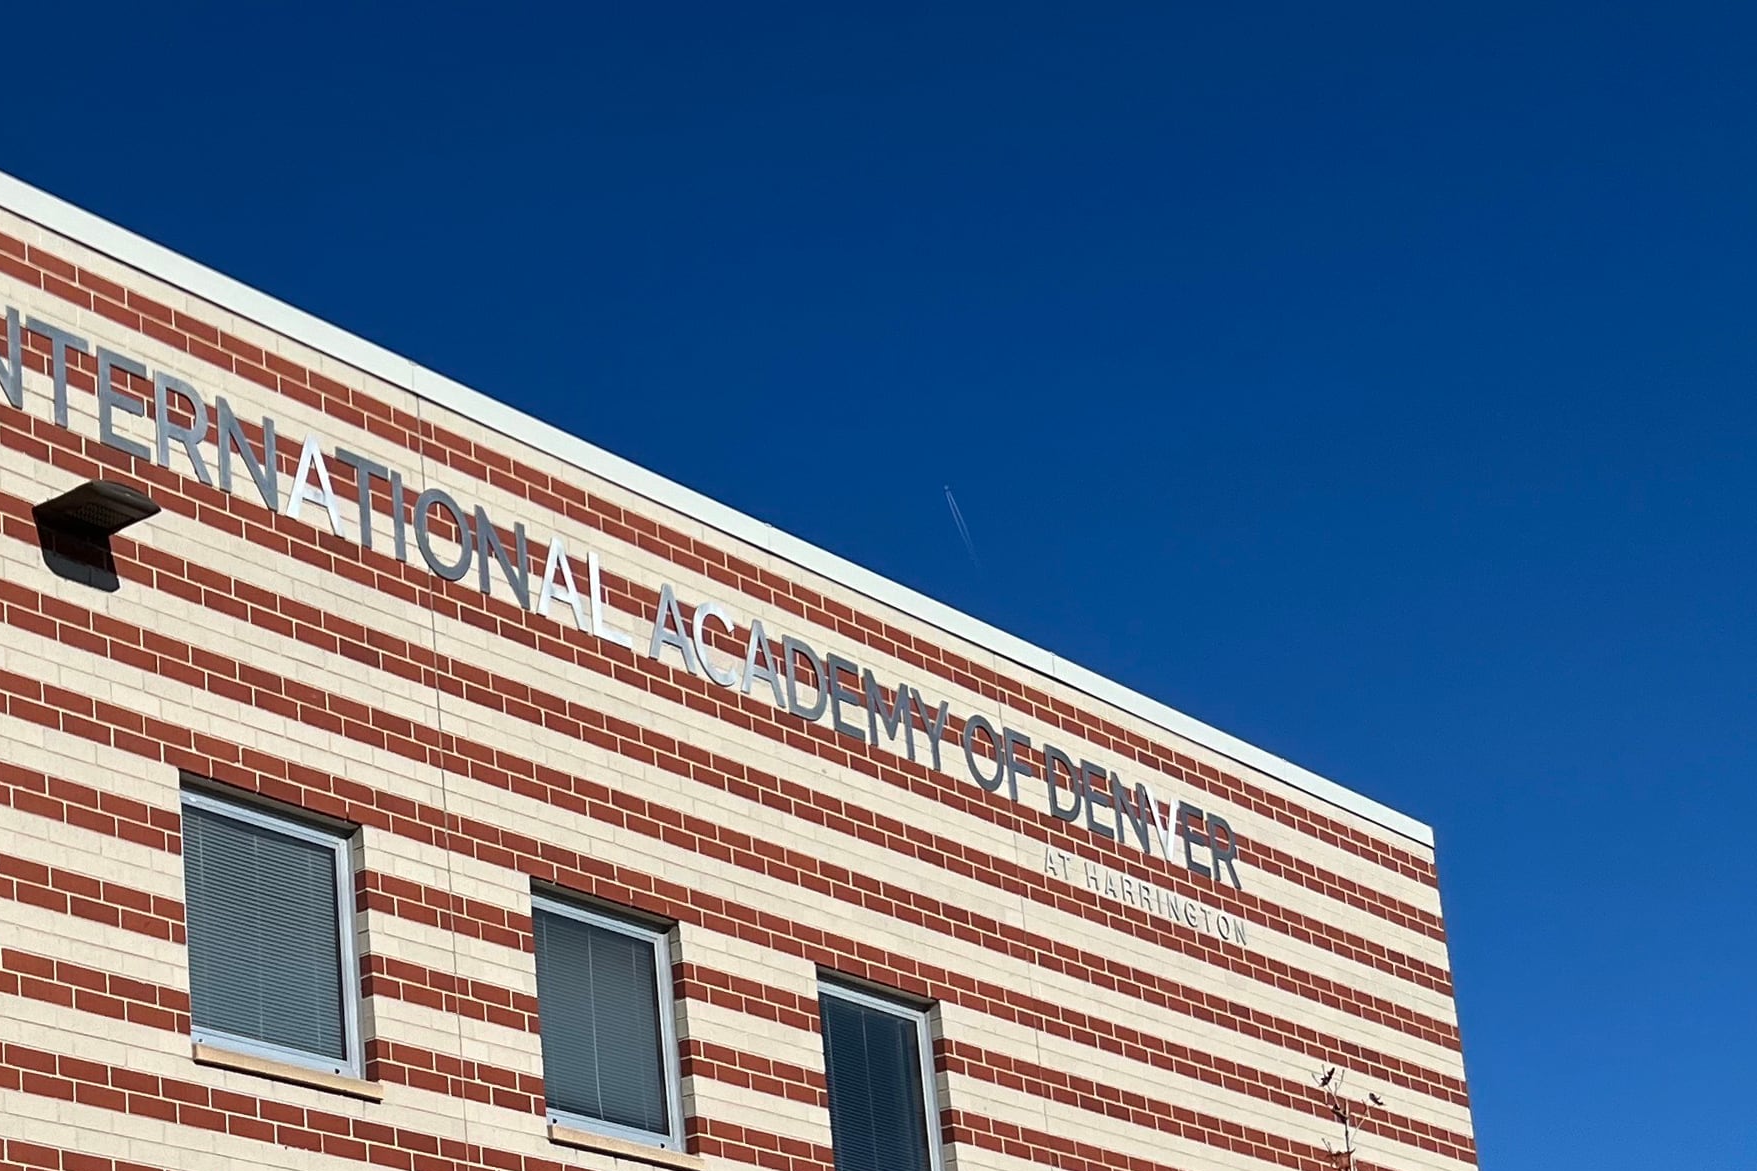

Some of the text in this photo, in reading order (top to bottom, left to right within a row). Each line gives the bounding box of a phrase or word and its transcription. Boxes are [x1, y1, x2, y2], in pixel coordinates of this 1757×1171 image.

[648, 583, 949, 772] ACADEMY
[963, 714, 1033, 801] OF
[1043, 742, 1242, 890] DENVER
[1044, 846, 1248, 946] AT HARRINGTON
